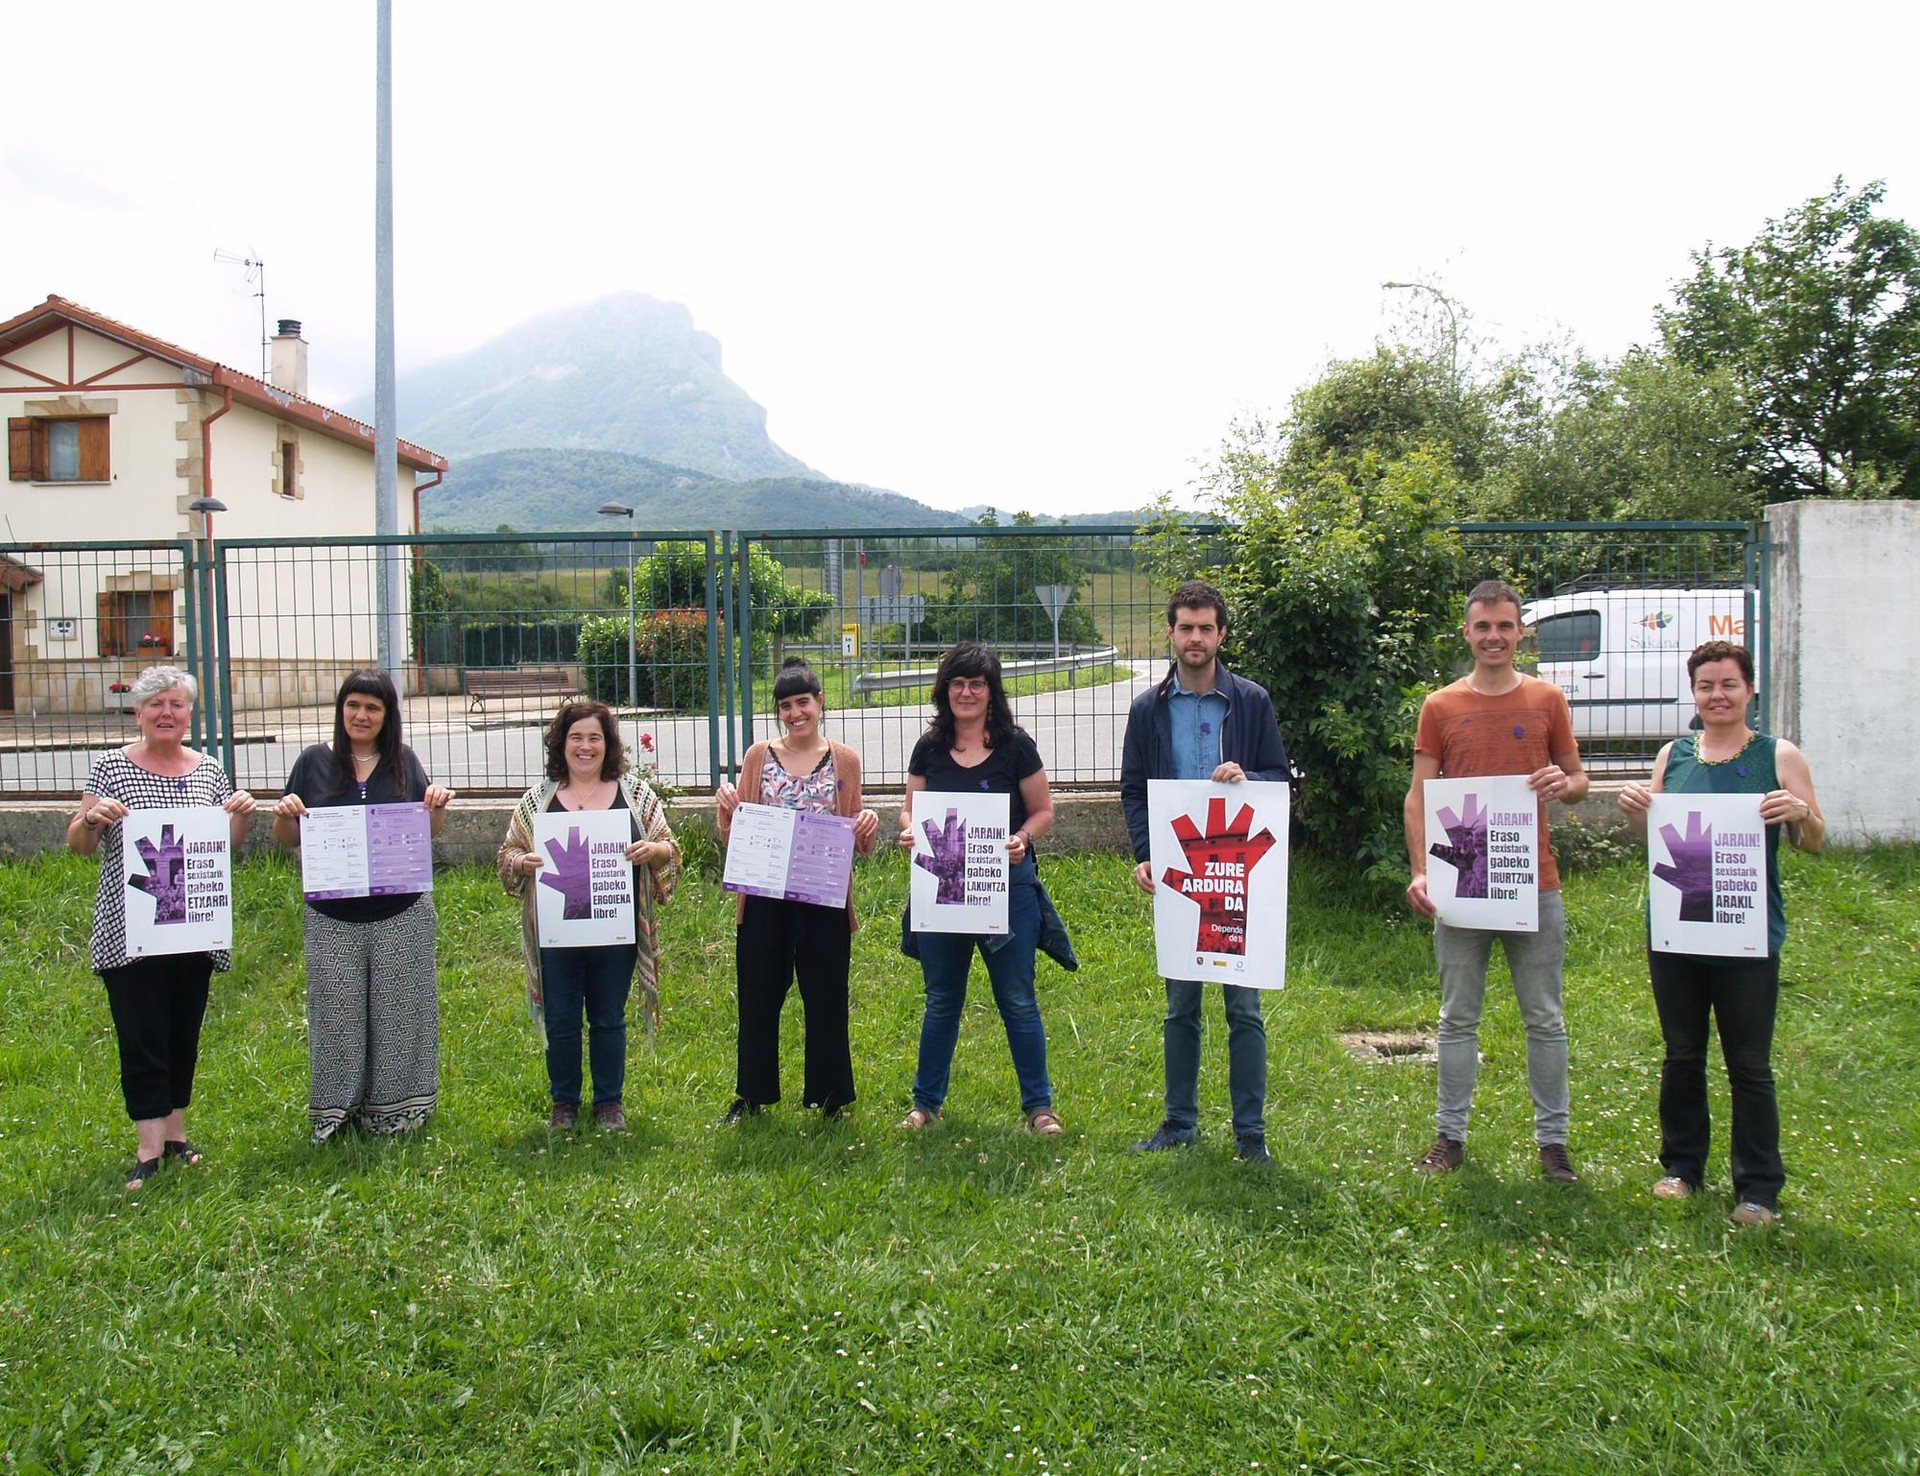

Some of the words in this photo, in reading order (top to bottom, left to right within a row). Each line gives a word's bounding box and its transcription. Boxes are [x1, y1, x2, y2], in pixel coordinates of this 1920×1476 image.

[1631, 635, 1679, 649] Sakana
[1490, 813, 1532, 826] JARAIN!
[968, 827, 1005, 840] JARAIN!
[1491, 831, 1519, 842] Eraso
[1715, 833, 1760, 847] JARAIN!
[186, 841, 226, 854] JARAIN!
[591, 842, 628, 854] JARAIN!
[968, 843, 993, 854] Eraso
[1491, 845, 1529, 853] sexistarik
[187, 858, 214, 869] Eraso
[592, 859, 617, 868] Eraso
[968, 856, 1002, 864] sexistarik
[1491, 856, 1529, 868] gabeko
[1716, 851, 1746, 864] Eraso
[187, 870, 223, 880] sexistarik
[593, 870, 626, 878] sexistarik
[967, 867, 1001, 878] gabeko
[1205, 862, 1244, 877] ZURE
[1716, 867, 1757, 876] sexistarik
[1491, 873, 1534, 884] IRURTZUN
[188, 882, 223, 895] gabeko
[593, 880, 626, 892] gabeko
[967, 882, 1006, 892] LAKUNTZA
[1182, 878, 1244, 894] ARDURA
[1716, 879, 1757, 891] gabeko
[593, 894, 631, 905] ERGOIENA
[1491, 888, 1518, 900] libre!
[188, 895, 228, 909] ETXARRI
[967, 895, 991, 906] libre!
[1224, 896, 1244, 911] DA
[1716, 895, 1754, 909] ARAKIL
[188, 911, 214, 923] libre!
[594, 908, 617, 918] libre!
[1716, 910, 1745, 924] libre!
[1211, 924, 1243, 934] Depende
[1229, 934, 1238, 942] de
[1239, 934, 1243, 943] ti
